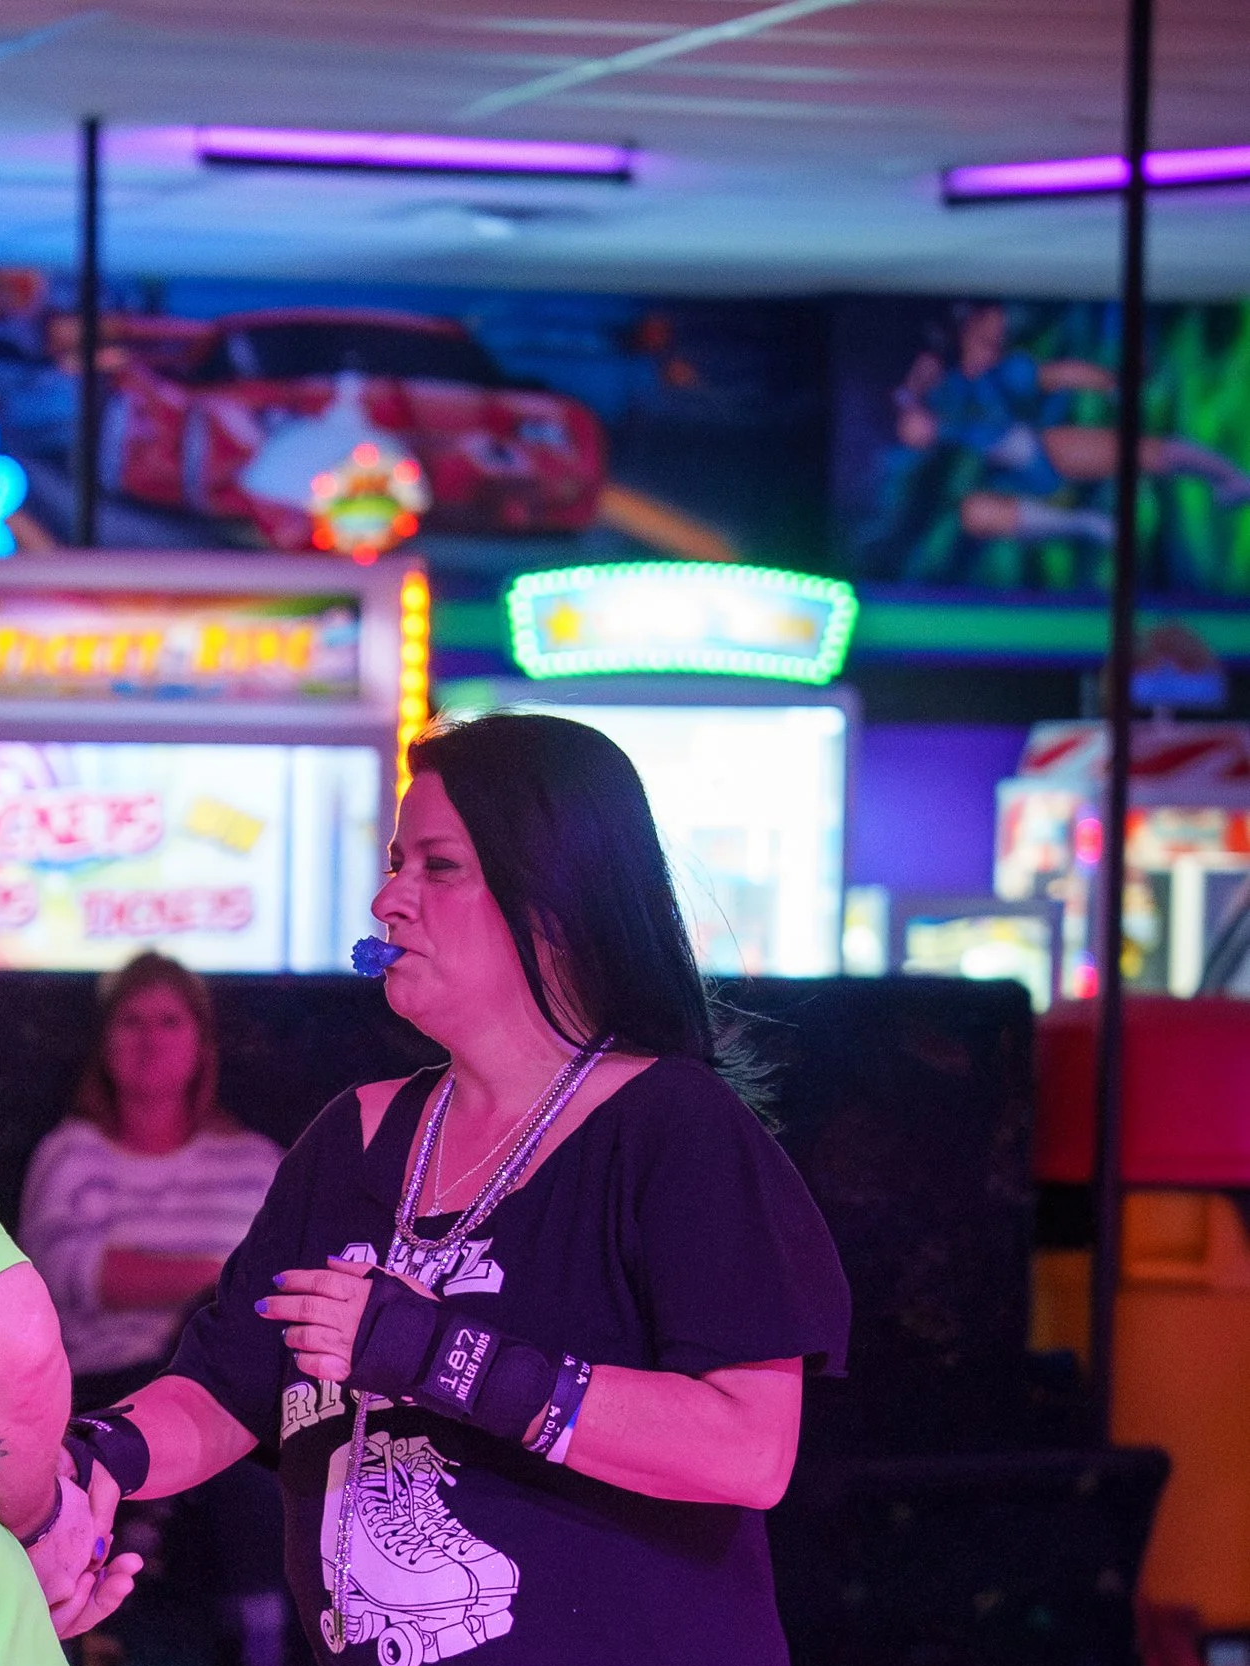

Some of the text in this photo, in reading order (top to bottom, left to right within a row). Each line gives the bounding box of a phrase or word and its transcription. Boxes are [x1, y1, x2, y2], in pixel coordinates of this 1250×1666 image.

[439, 1328, 475, 1390] 187
[456, 1332, 491, 1400] KILLER PADS
